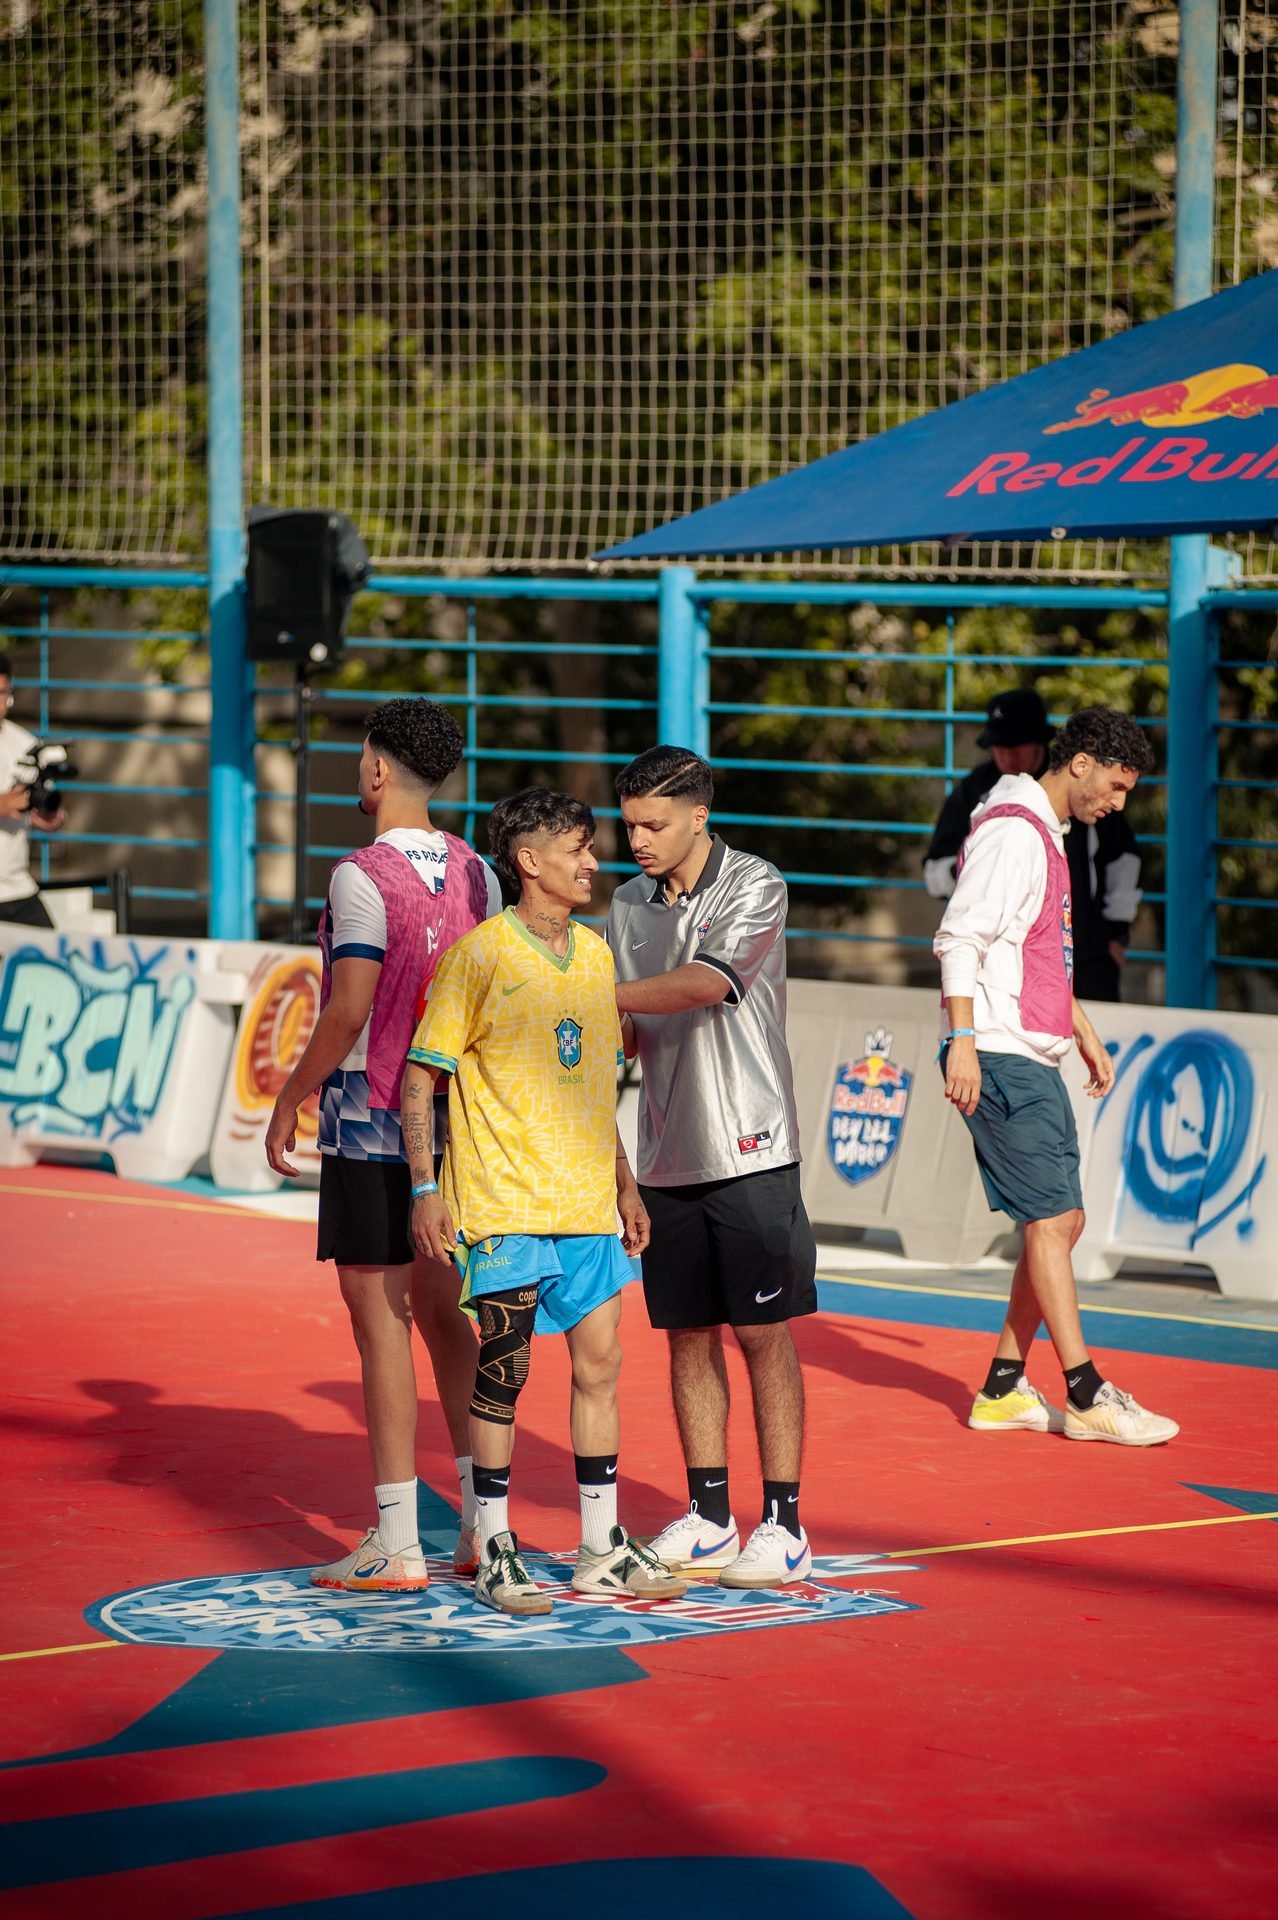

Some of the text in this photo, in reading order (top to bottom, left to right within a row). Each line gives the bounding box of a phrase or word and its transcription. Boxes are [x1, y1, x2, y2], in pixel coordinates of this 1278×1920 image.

[945, 437, 1278, 498] Red Bul
[405, 850, 421, 860] FS
[0, 957, 195, 1118] BCN
[562, 1039, 574, 1048] CBF
[558, 1074, 586, 1086] BRASIL
[832, 1083, 908, 1118] Red Bull
[474, 1255, 513, 1273] BRASIL
